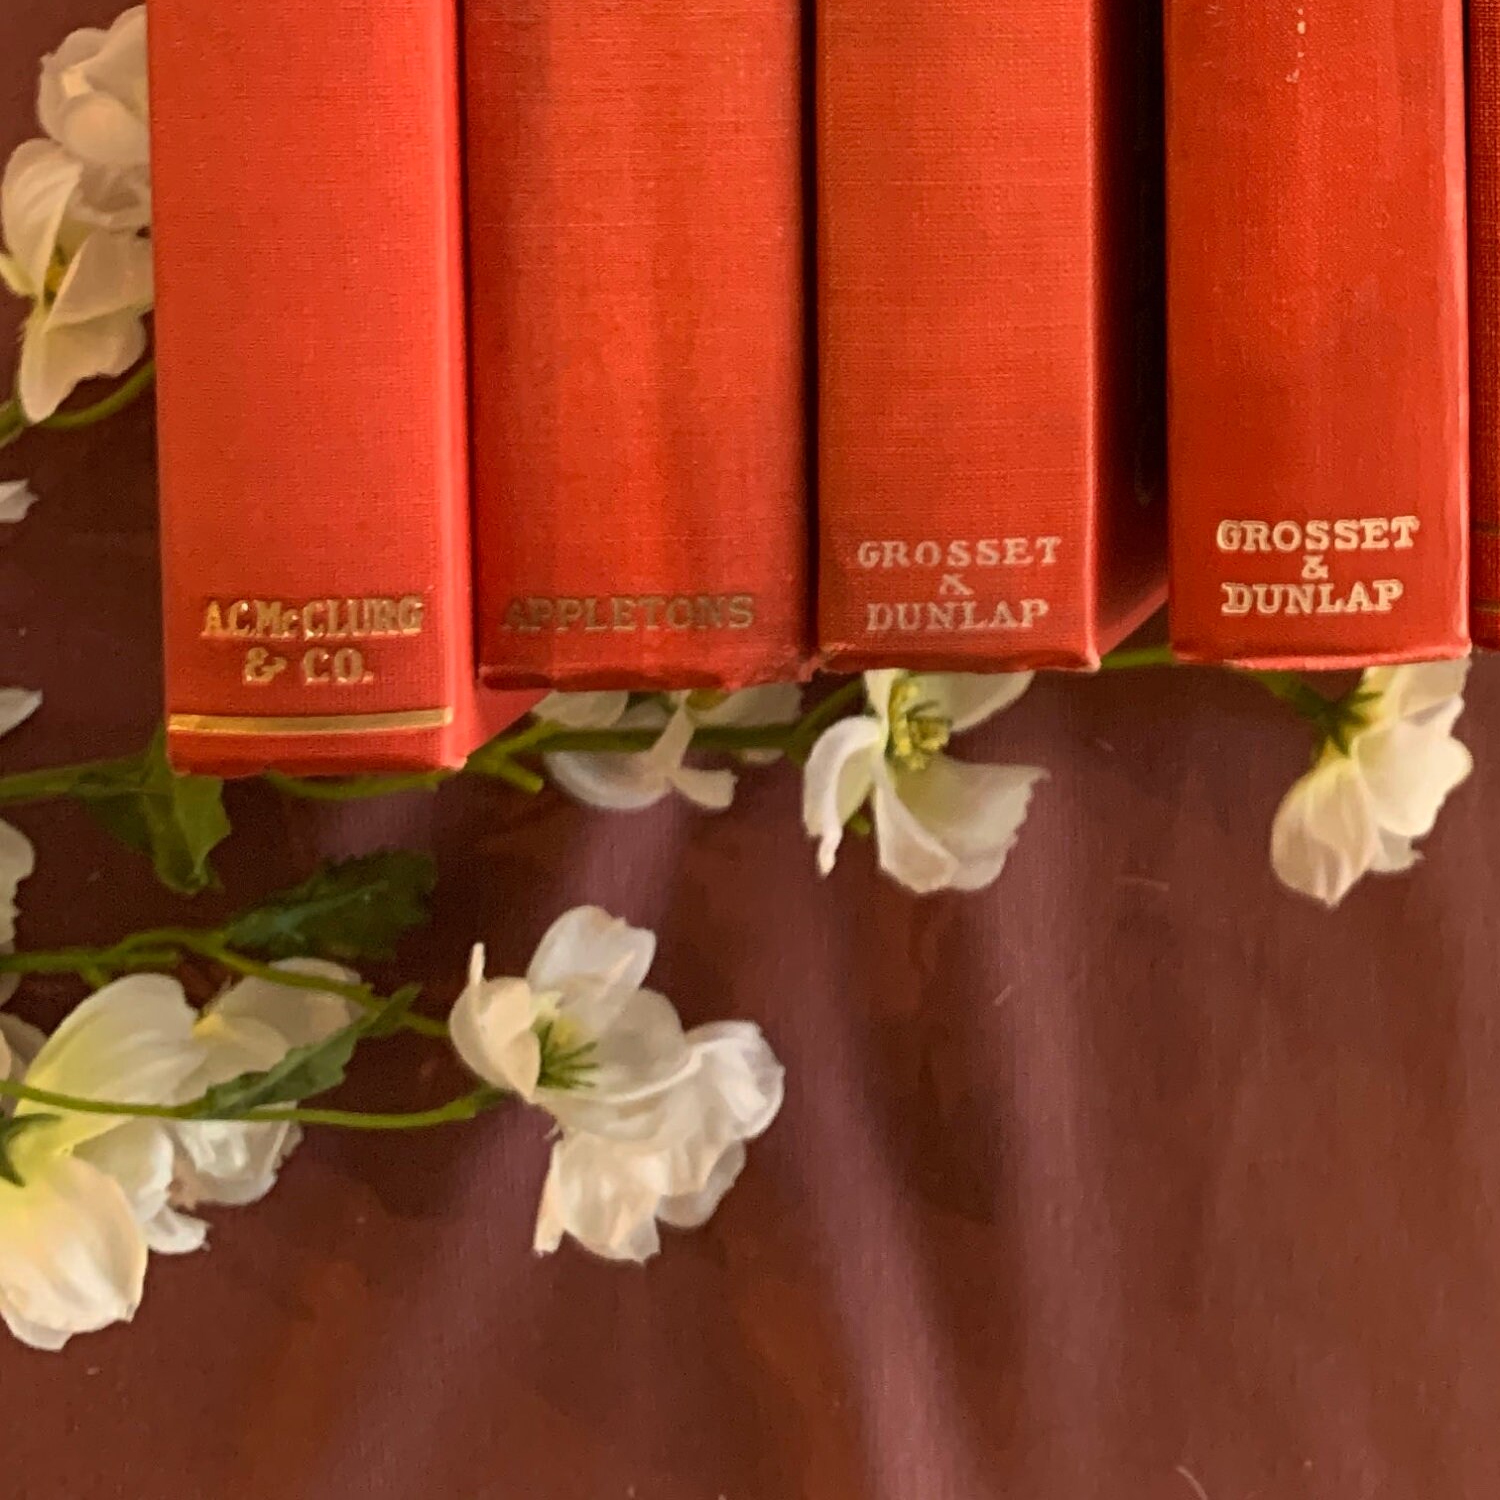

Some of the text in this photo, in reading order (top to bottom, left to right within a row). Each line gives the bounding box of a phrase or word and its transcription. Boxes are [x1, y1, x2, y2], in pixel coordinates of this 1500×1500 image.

[1216, 515, 1419, 552] GROSSET
[857, 537, 1062, 569] GROSSET
[1301, 555, 1330, 581] &
[938, 572, 974, 596] &
[1220, 580, 1404, 615] DUNLAP
[500, 595, 756, 632] APPLETONS
[866, 599, 1050, 631] DUNLAP
[243, 649, 286, 686] &
